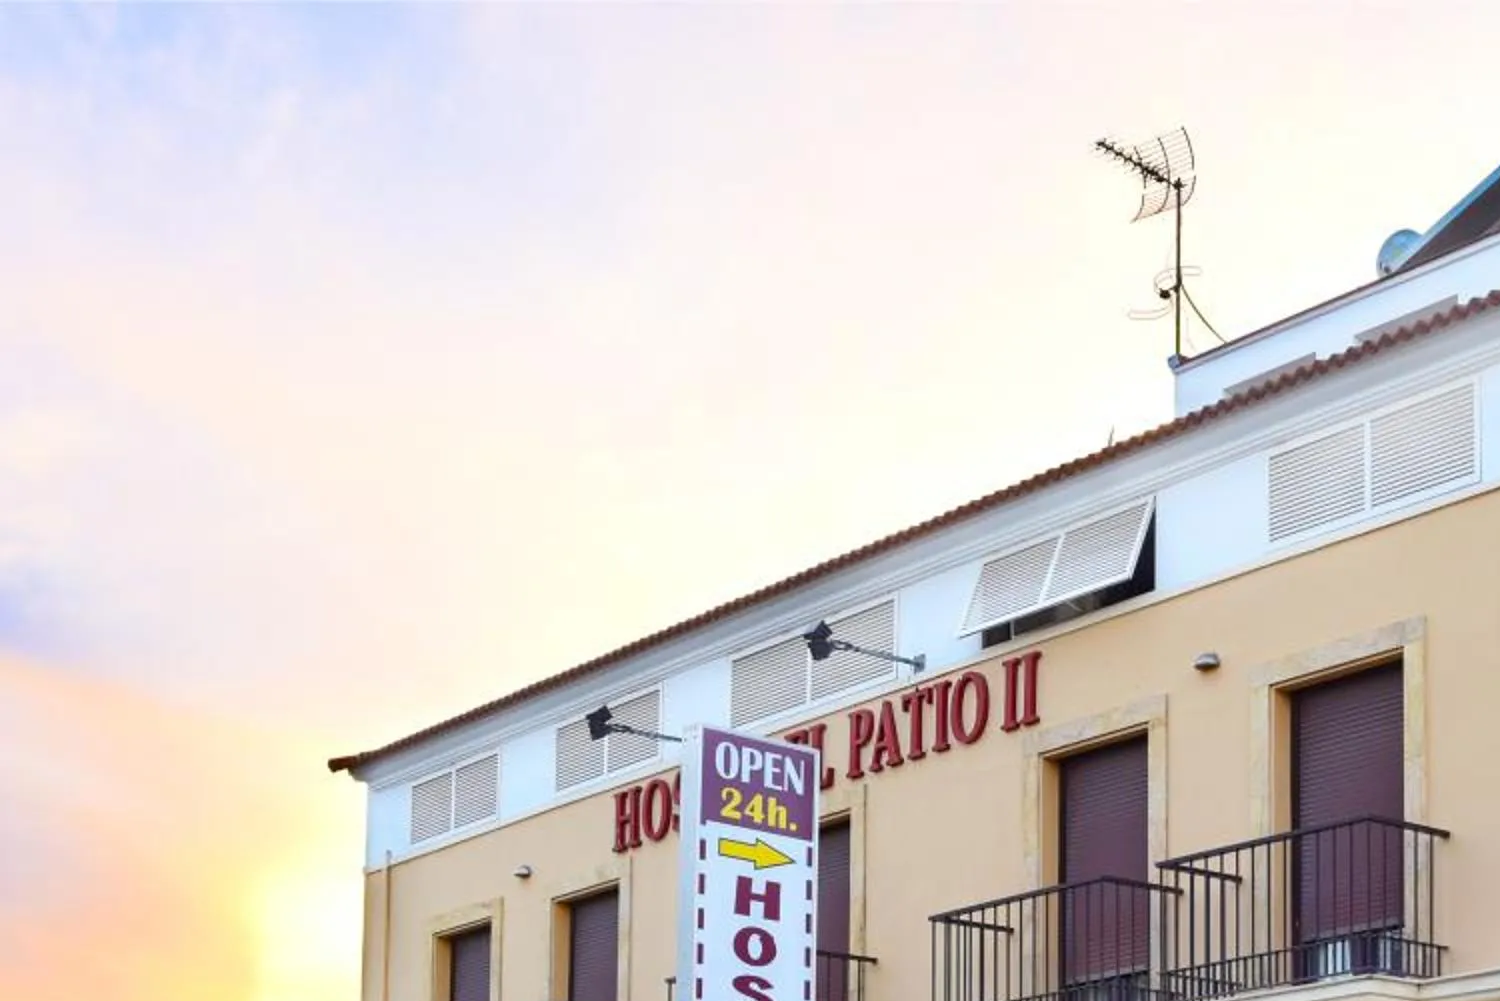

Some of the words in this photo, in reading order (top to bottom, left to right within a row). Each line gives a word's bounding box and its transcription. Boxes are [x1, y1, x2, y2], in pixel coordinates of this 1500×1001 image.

[846, 671, 990, 779] PATIO
[1000, 651, 1043, 733] II
[715, 741, 805, 797] OPEN
[720, 786, 798, 832] 24h.
